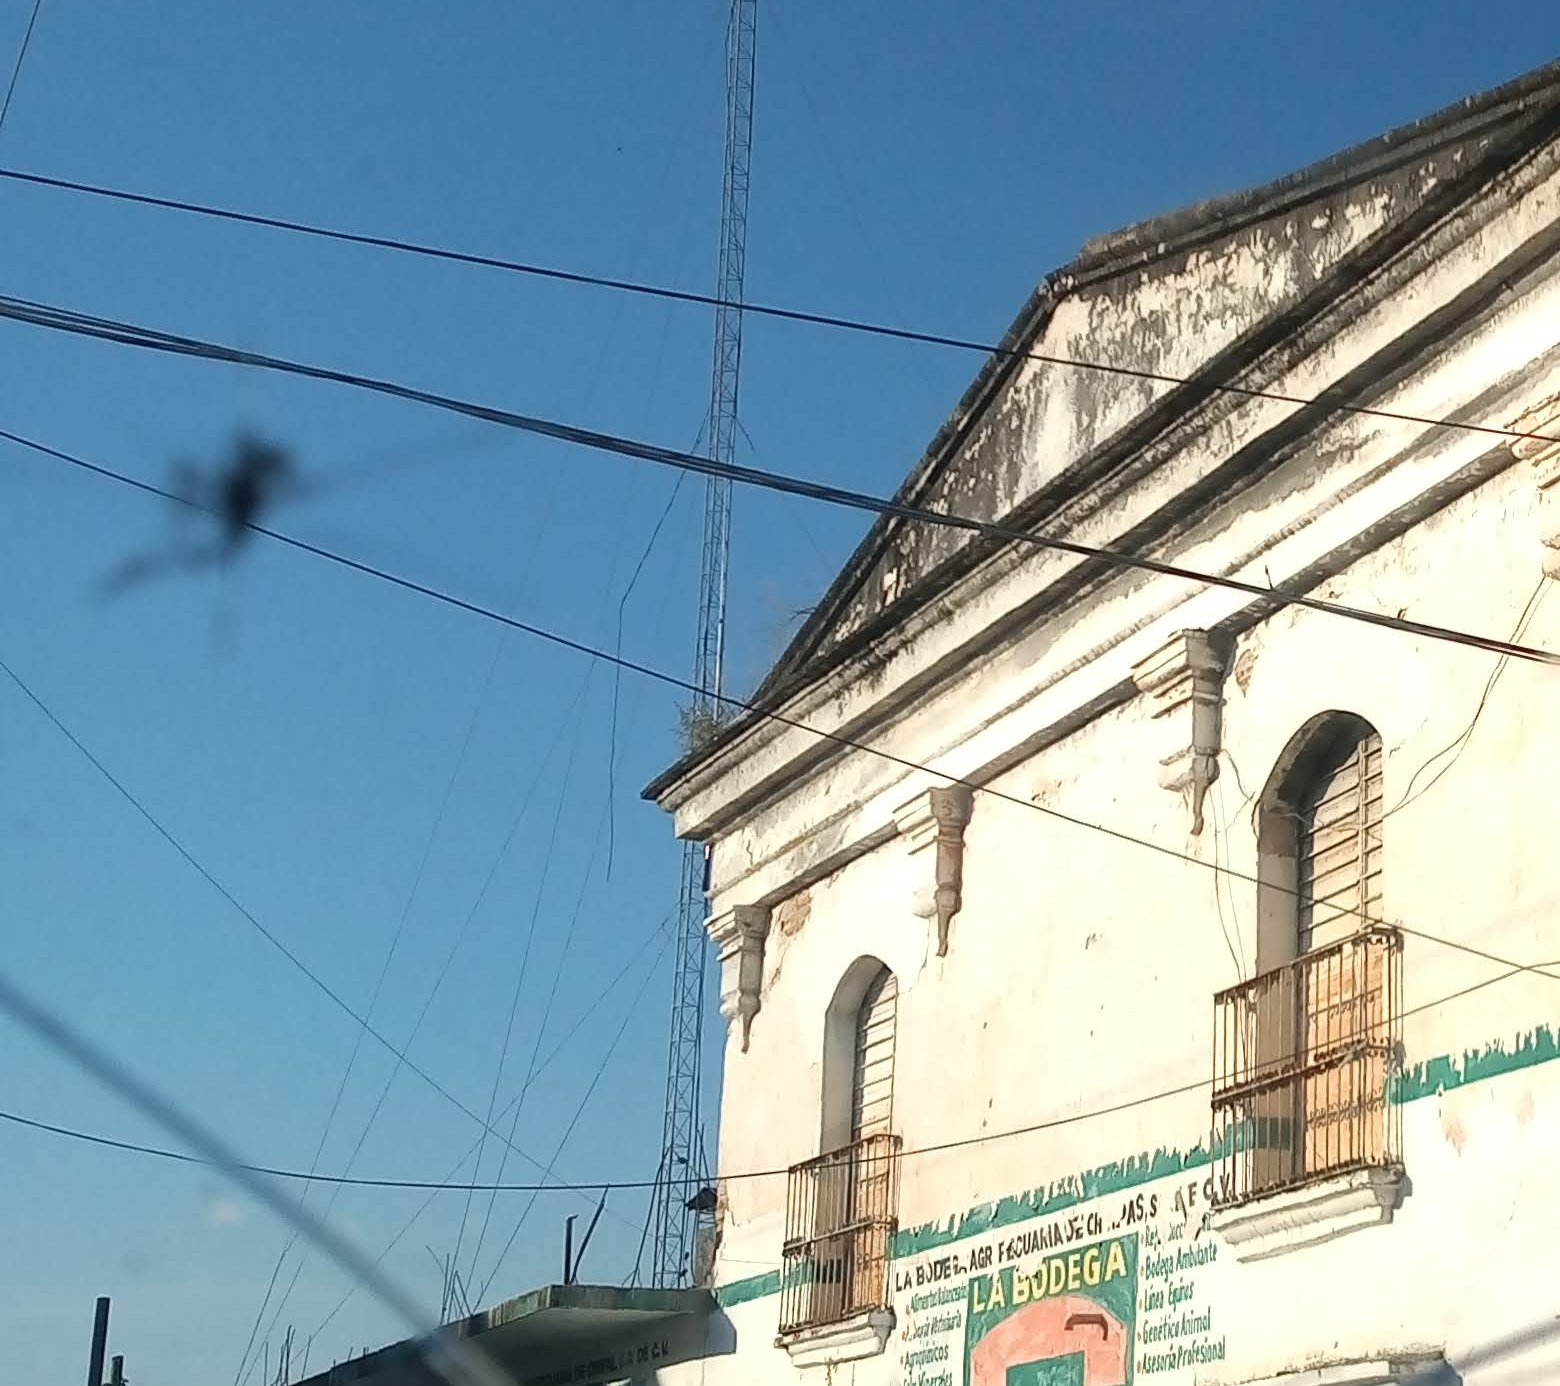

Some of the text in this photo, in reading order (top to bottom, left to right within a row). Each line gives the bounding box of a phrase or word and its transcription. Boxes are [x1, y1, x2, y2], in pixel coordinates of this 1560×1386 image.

[972, 1241, 1127, 1314] LA BODEGA
[1146, 1239, 1217, 1283] Bodega Ambulante
[1180, 1306, 1211, 1336] Animal
[1177, 1335, 1226, 1370] Profesional
